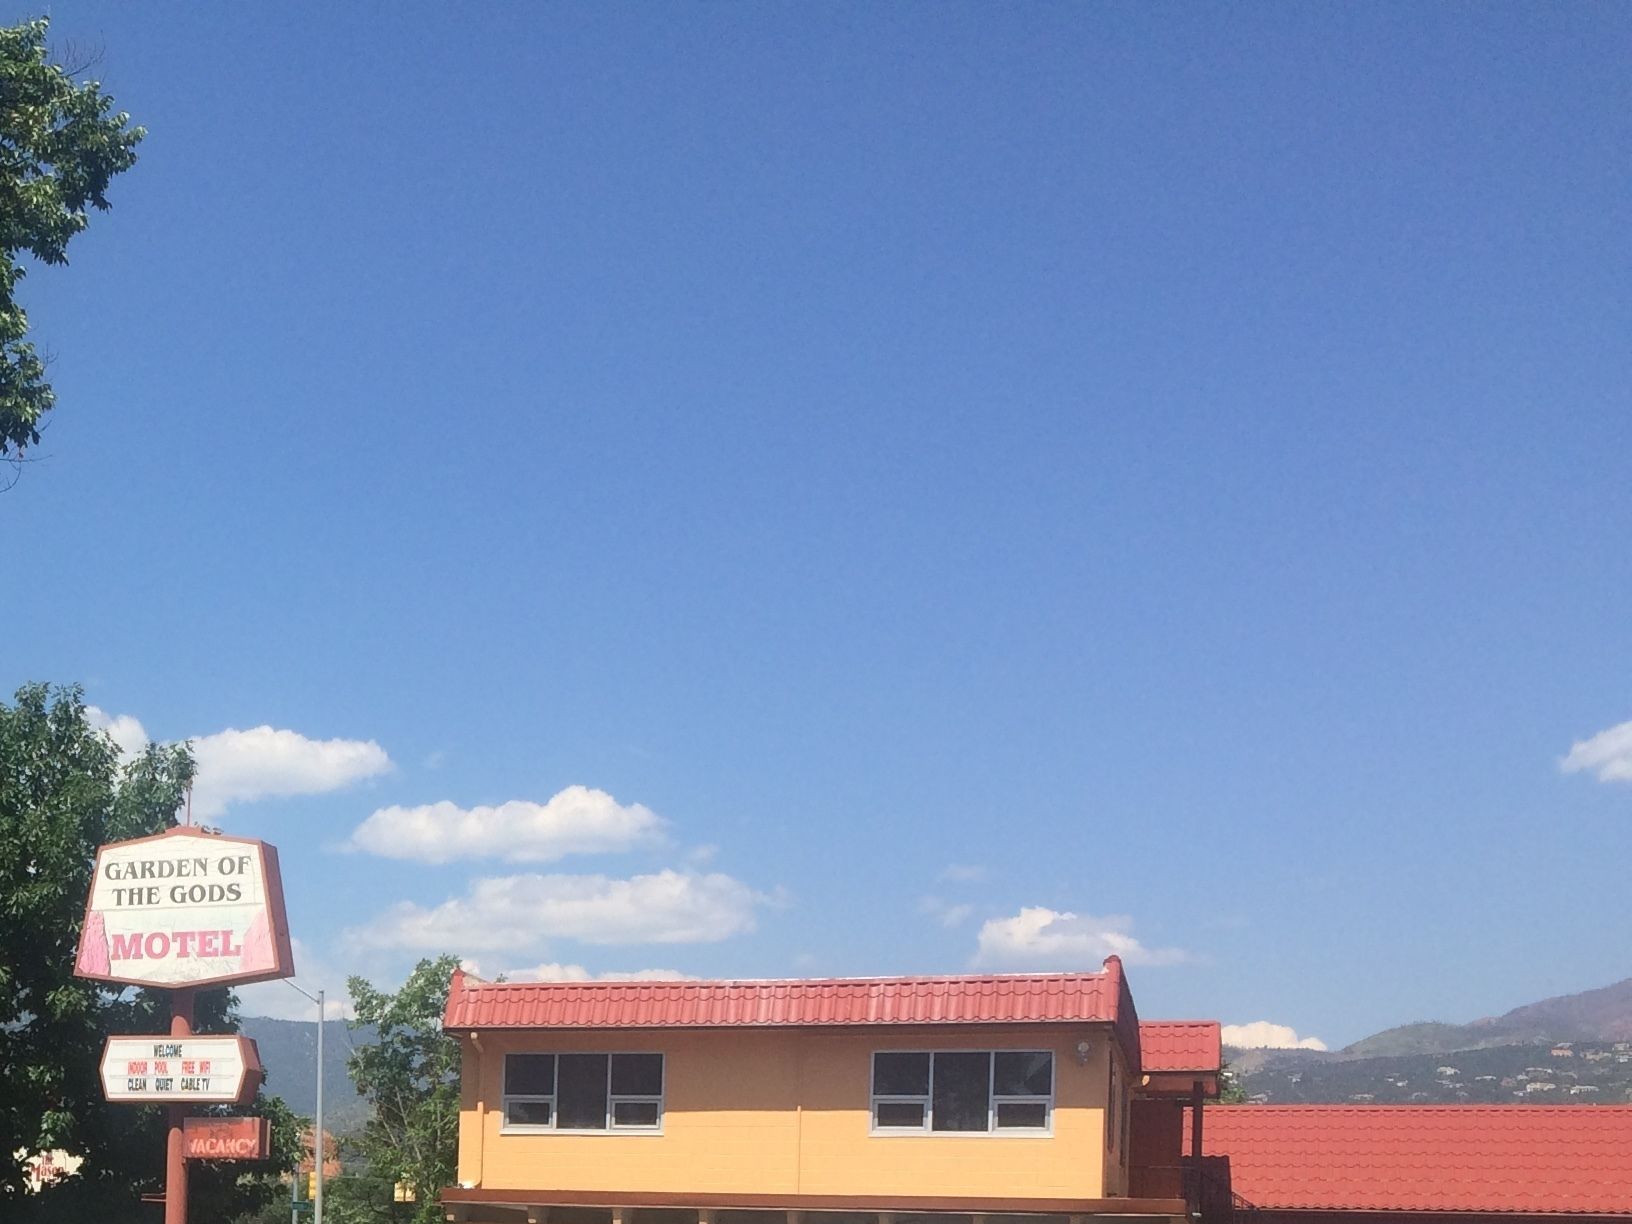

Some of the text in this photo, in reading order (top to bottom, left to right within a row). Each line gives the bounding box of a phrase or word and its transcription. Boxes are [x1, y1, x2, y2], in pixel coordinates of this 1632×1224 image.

[105, 855, 252, 881] GARDEN OF
[111, 883, 243, 907] THE GODS
[111, 929, 242, 961] MOTEL
[153, 1044, 183, 1058] WELCOME
[181, 1061, 196, 1075] FREE
[128, 1078, 210, 1091] CLEAN QUIET CABLE TV
[190, 1138, 256, 1154] VACANCY
